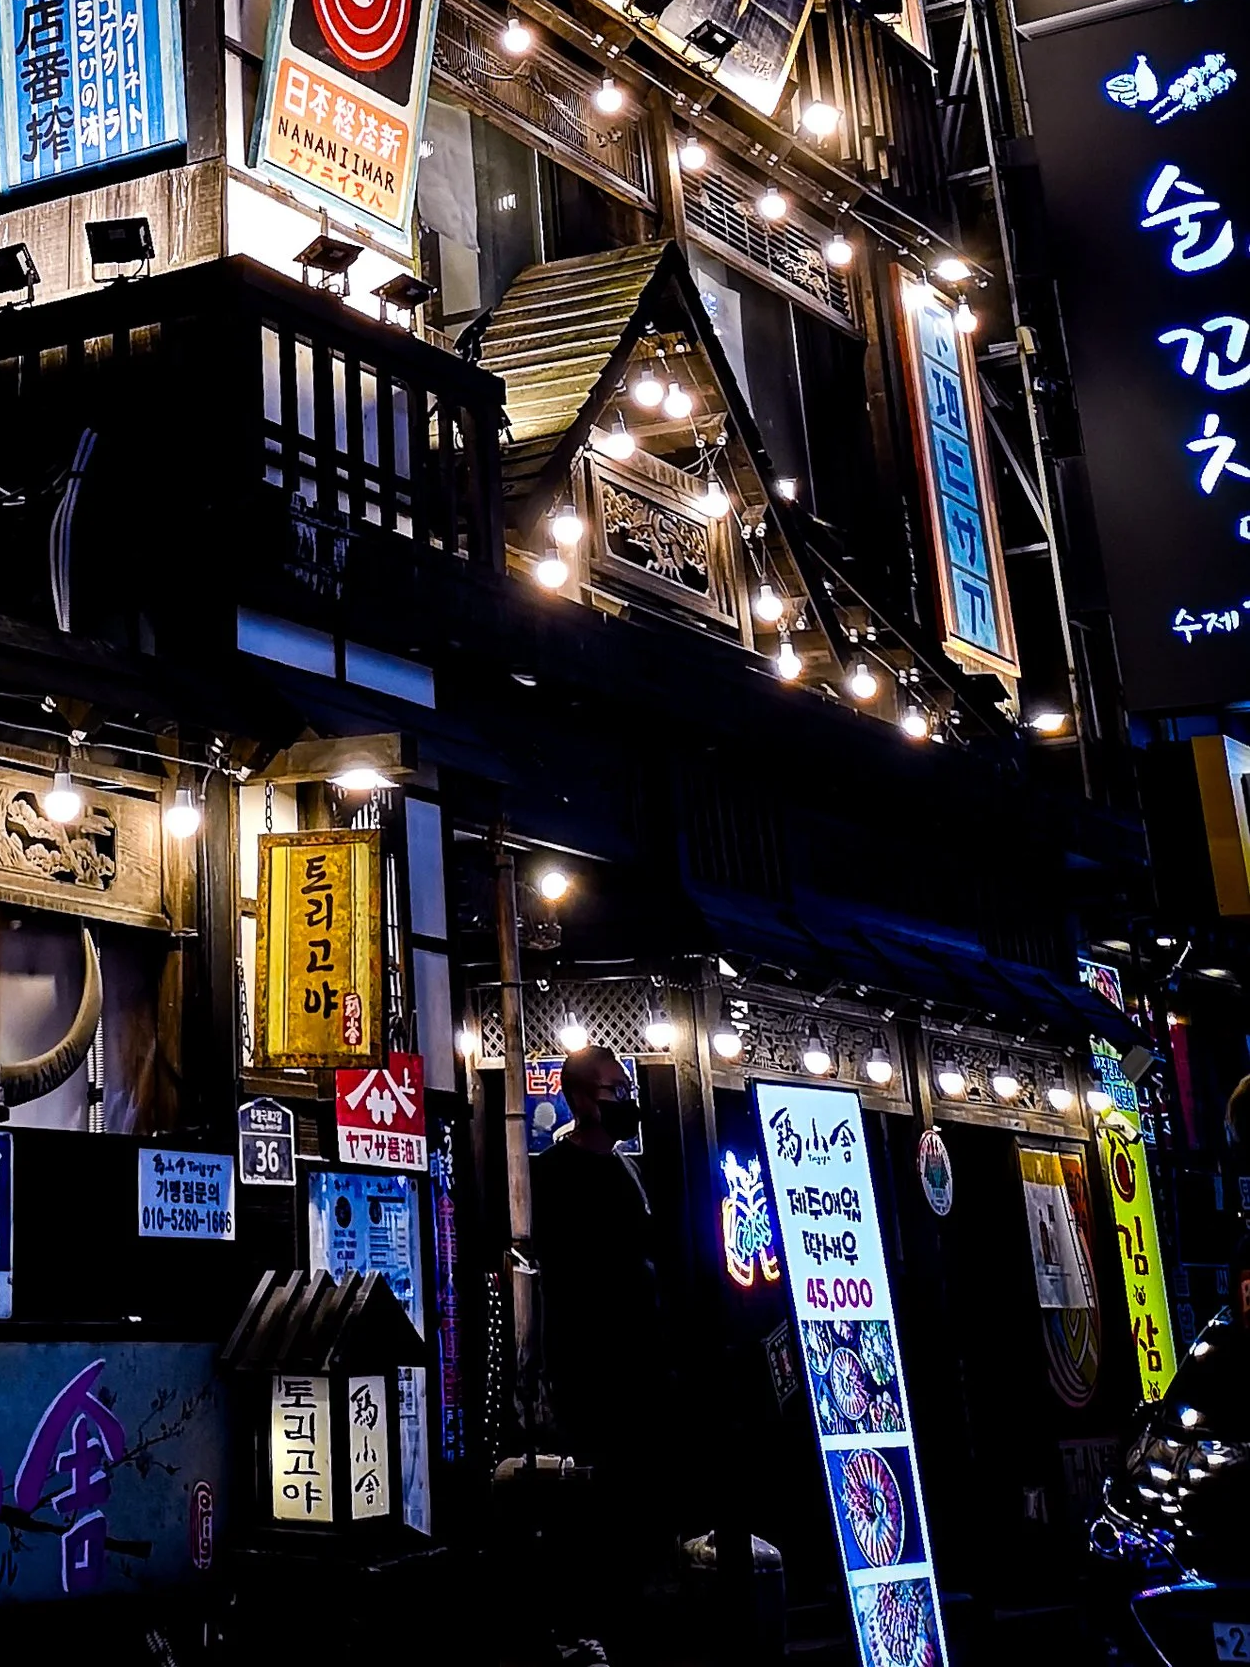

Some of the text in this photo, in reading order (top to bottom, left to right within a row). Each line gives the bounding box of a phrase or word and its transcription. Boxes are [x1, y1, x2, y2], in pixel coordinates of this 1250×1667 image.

[1172, 599, 1250, 644] 수제
[301, 854, 338, 1019] 토리고야
[256, 1141, 279, 1172] 36
[346, 1131, 415, 1164] ヤマサ醤油
[143, 1206, 231, 1234] 010-5260-1666
[787, 1186, 861, 1223] 제주애월
[802, 1230, 858, 1266] 딱새우
[807, 1278, 873, 1312] 45,000
[281, 1380, 322, 1513] 토리고야
